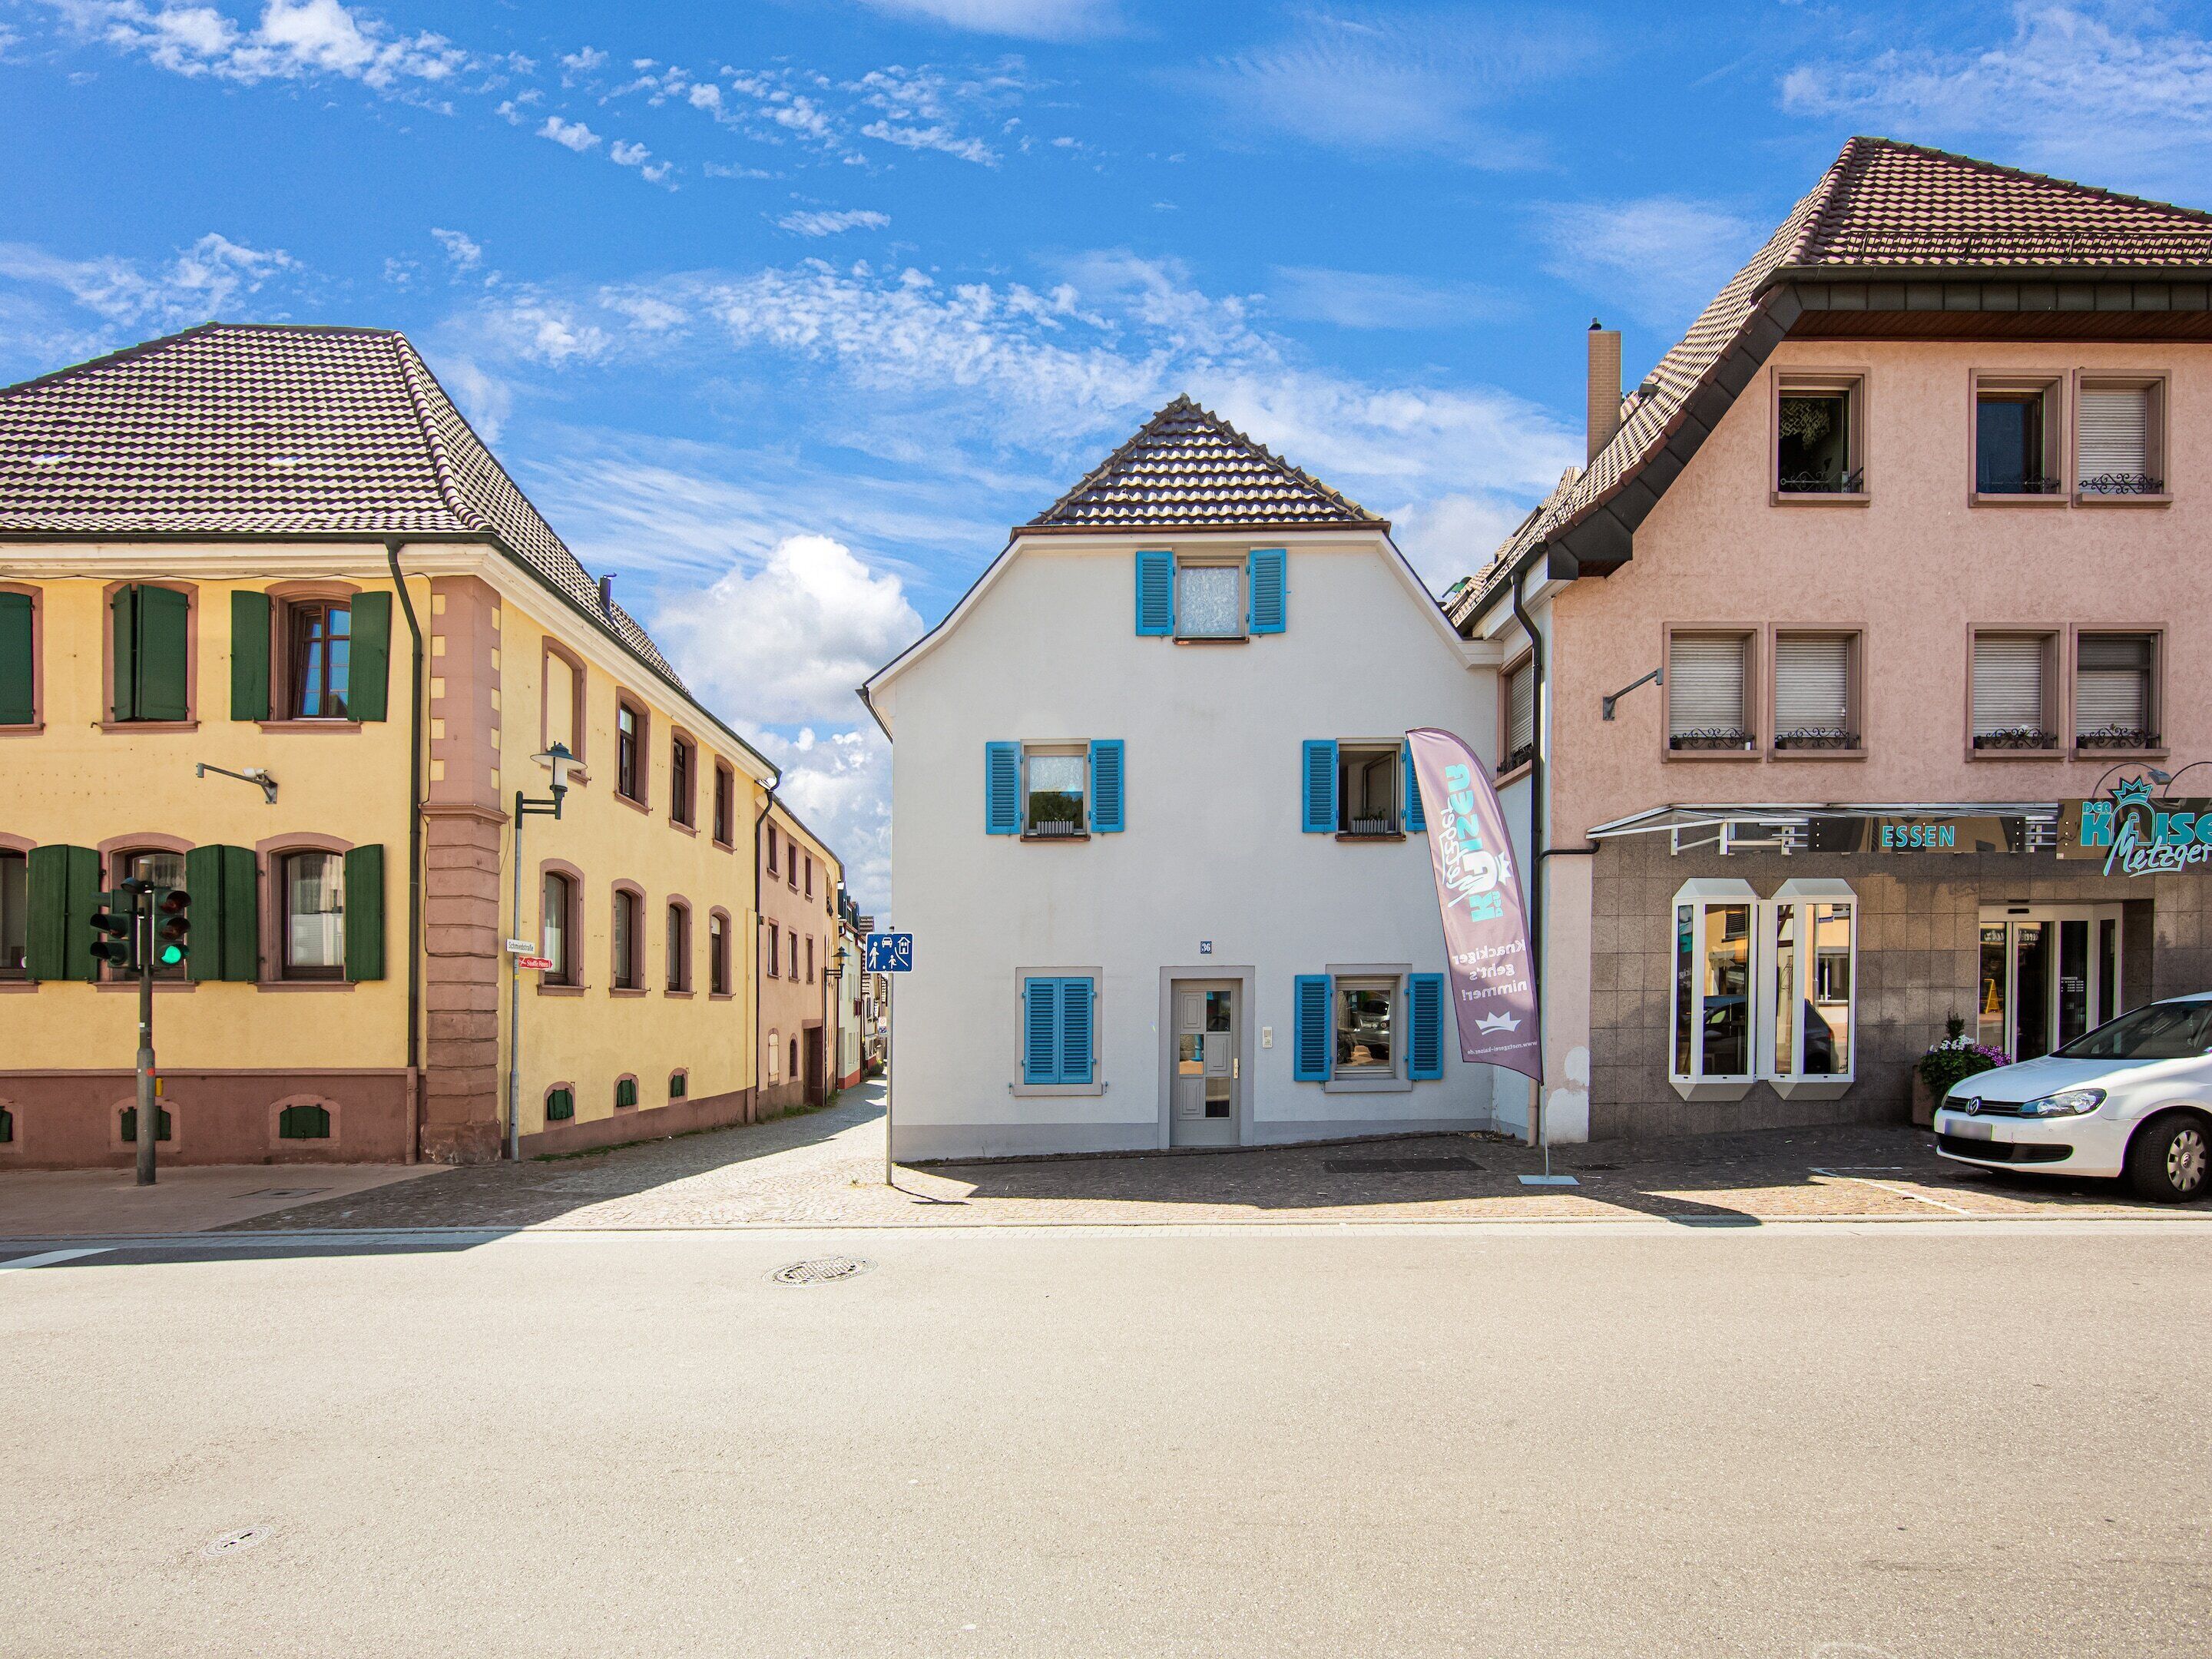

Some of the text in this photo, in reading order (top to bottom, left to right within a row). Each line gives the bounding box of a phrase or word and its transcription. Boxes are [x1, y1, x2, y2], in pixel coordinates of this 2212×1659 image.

[2082, 801, 2112, 813] DER
[1882, 825, 1955, 847] ESSEN
[508, 941, 534, 952] Schmiedstraße
[1202, 942, 1210, 952] 36
